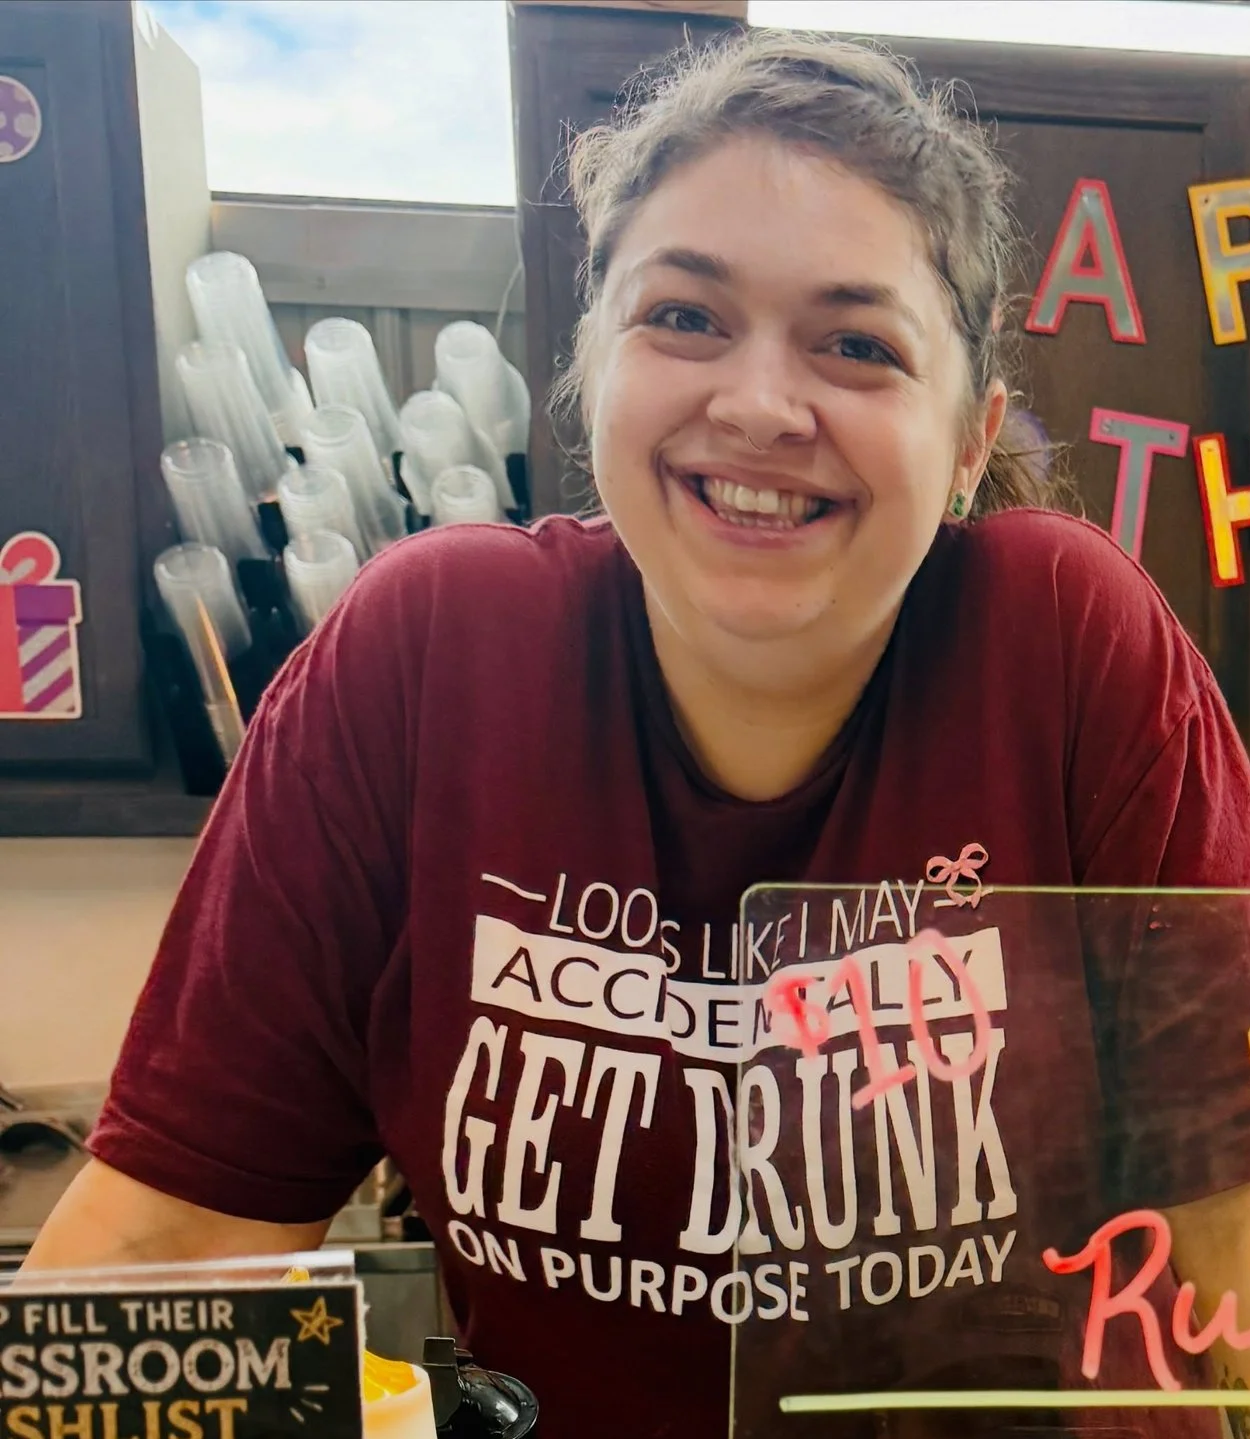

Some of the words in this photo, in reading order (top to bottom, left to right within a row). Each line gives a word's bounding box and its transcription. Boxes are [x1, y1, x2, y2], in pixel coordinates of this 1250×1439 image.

[548, 873, 681, 975] LOOS
[702, 913, 792, 981] LIKE
[798, 900, 810, 958] I
[829, 879, 925, 953] MAY
[492, 946, 973, 1049] ACCIDENALY
[441, 1016, 662, 1243] GET
[680, 1027, 1017, 1254] DRUNK
[24, 1304, 107, 1336] FILL
[121, 1300, 234, 1332] THEIR
[447, 1221, 526, 1282] ON
[541, 1255, 810, 1324] PURPOSE
[825, 1230, 1017, 1310] TODAY
[0, 1338, 291, 1398] SSROOM
